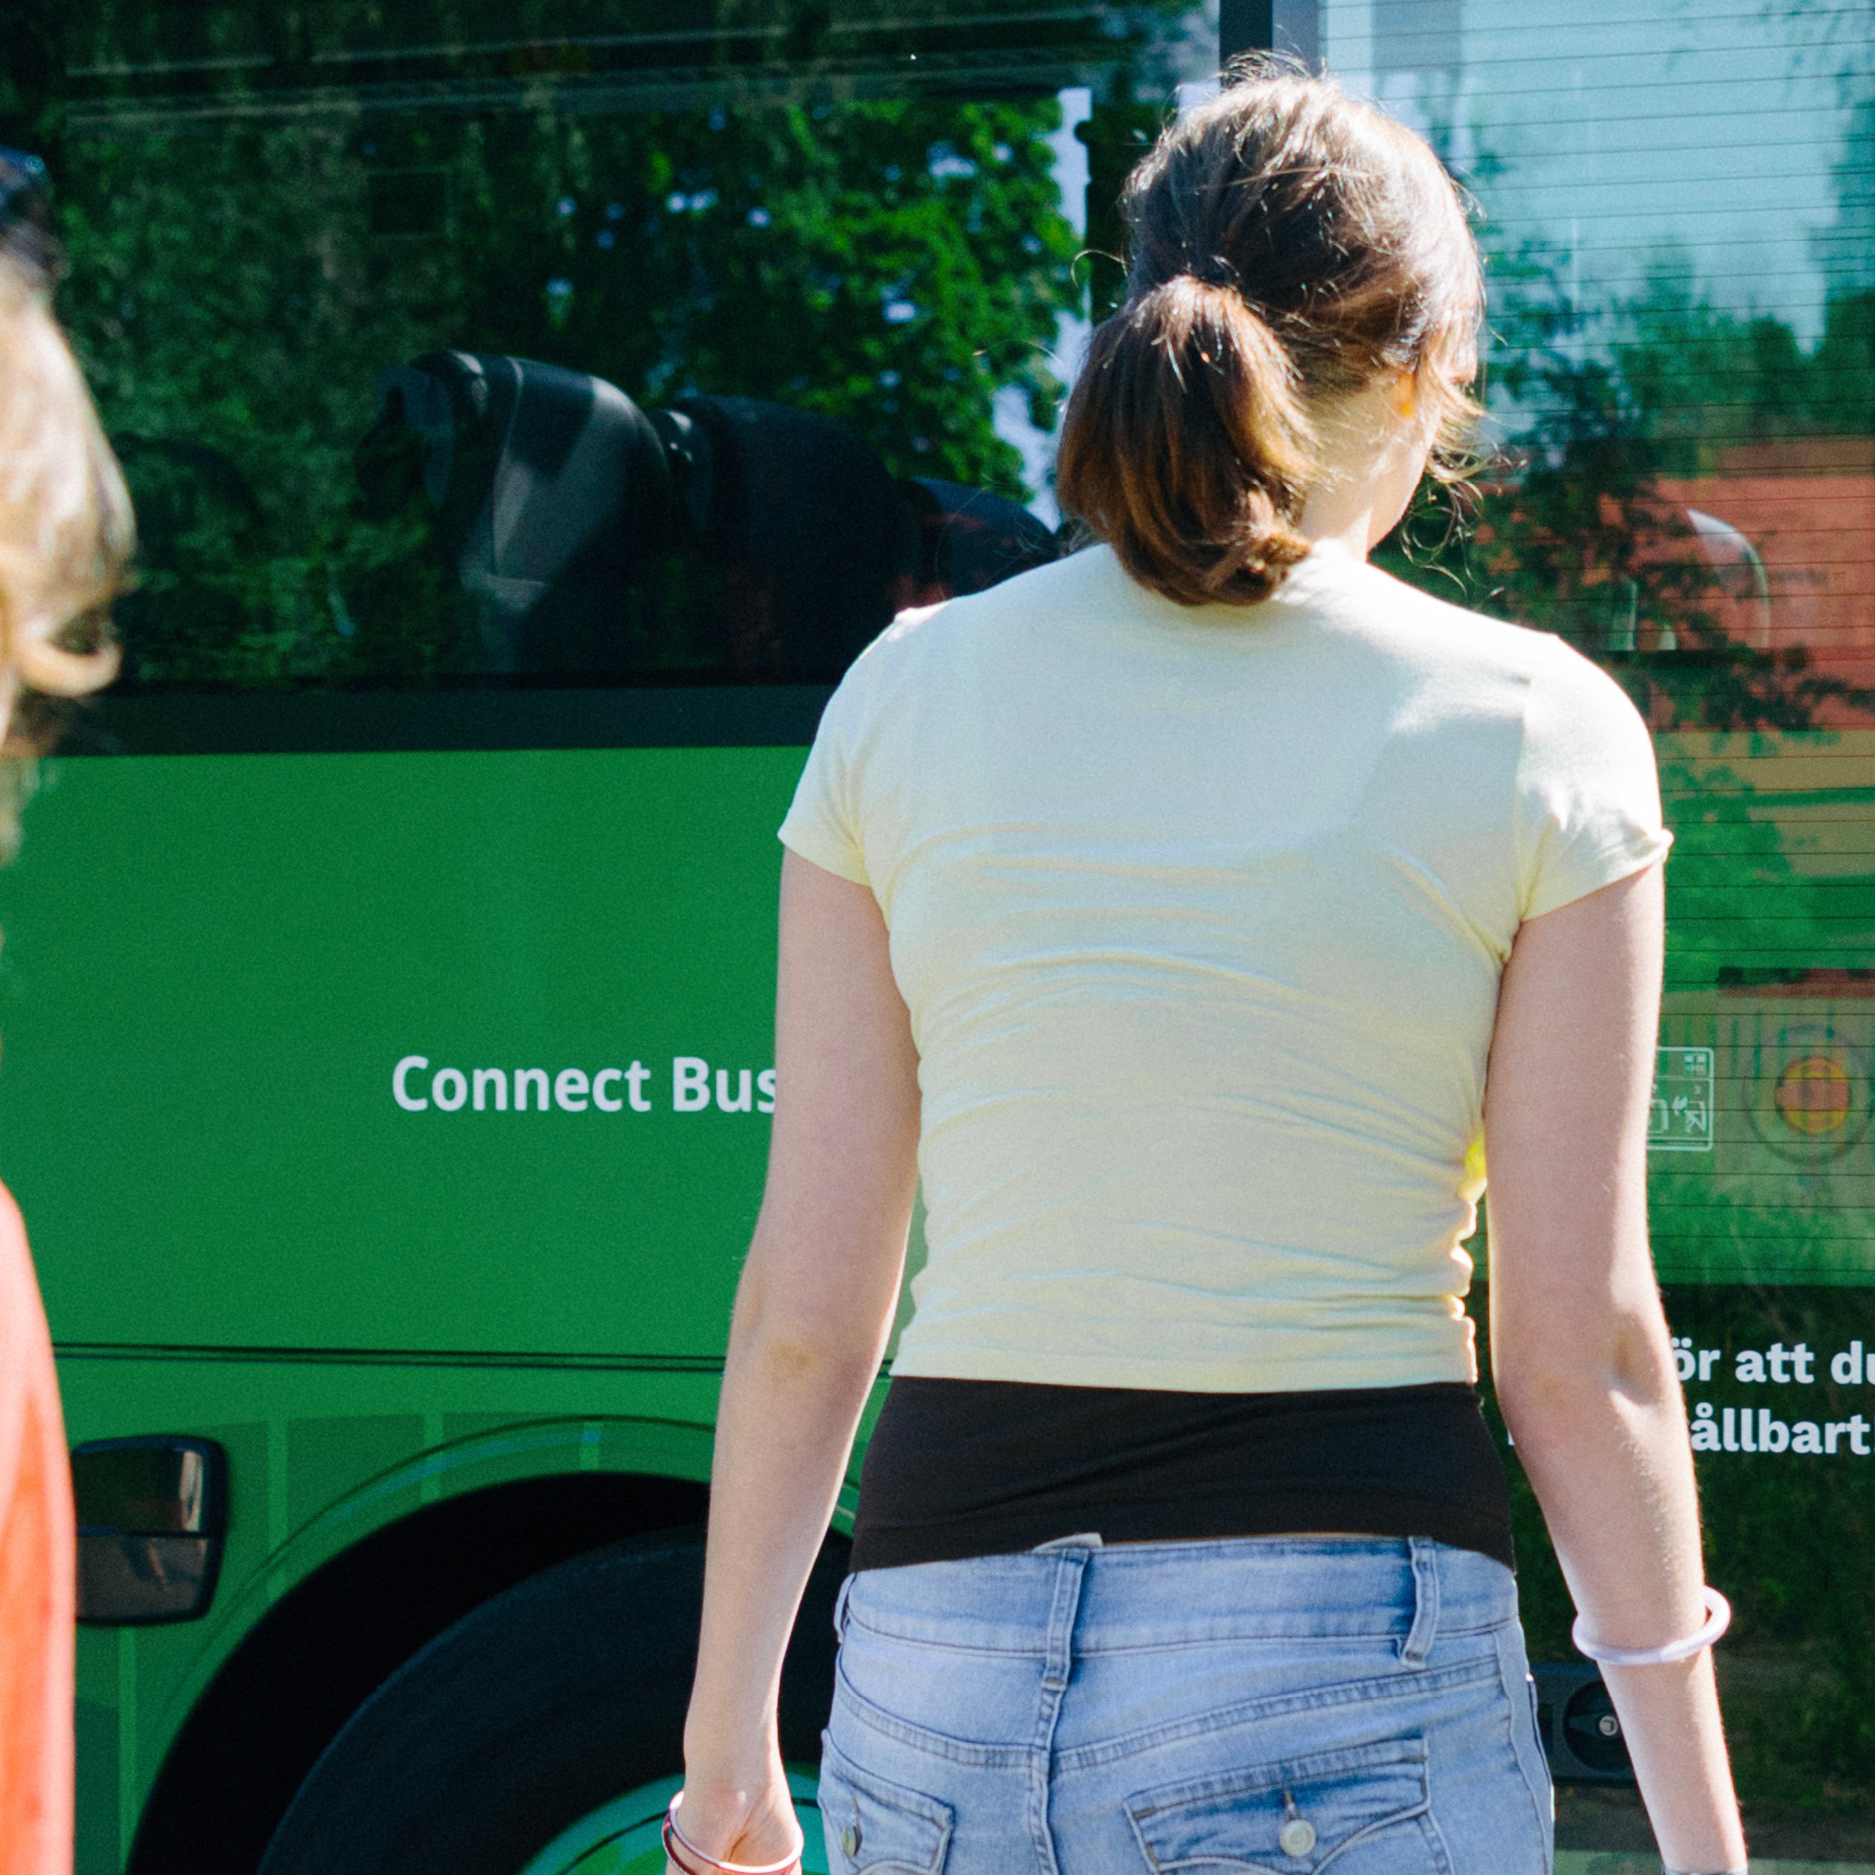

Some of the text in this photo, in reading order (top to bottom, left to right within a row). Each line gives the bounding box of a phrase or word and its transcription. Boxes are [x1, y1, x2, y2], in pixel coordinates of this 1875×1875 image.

[391, 1054, 652, 1113] Connect
[1670, 1336, 1722, 1382] ör
[1734, 1342, 1815, 1384] att
